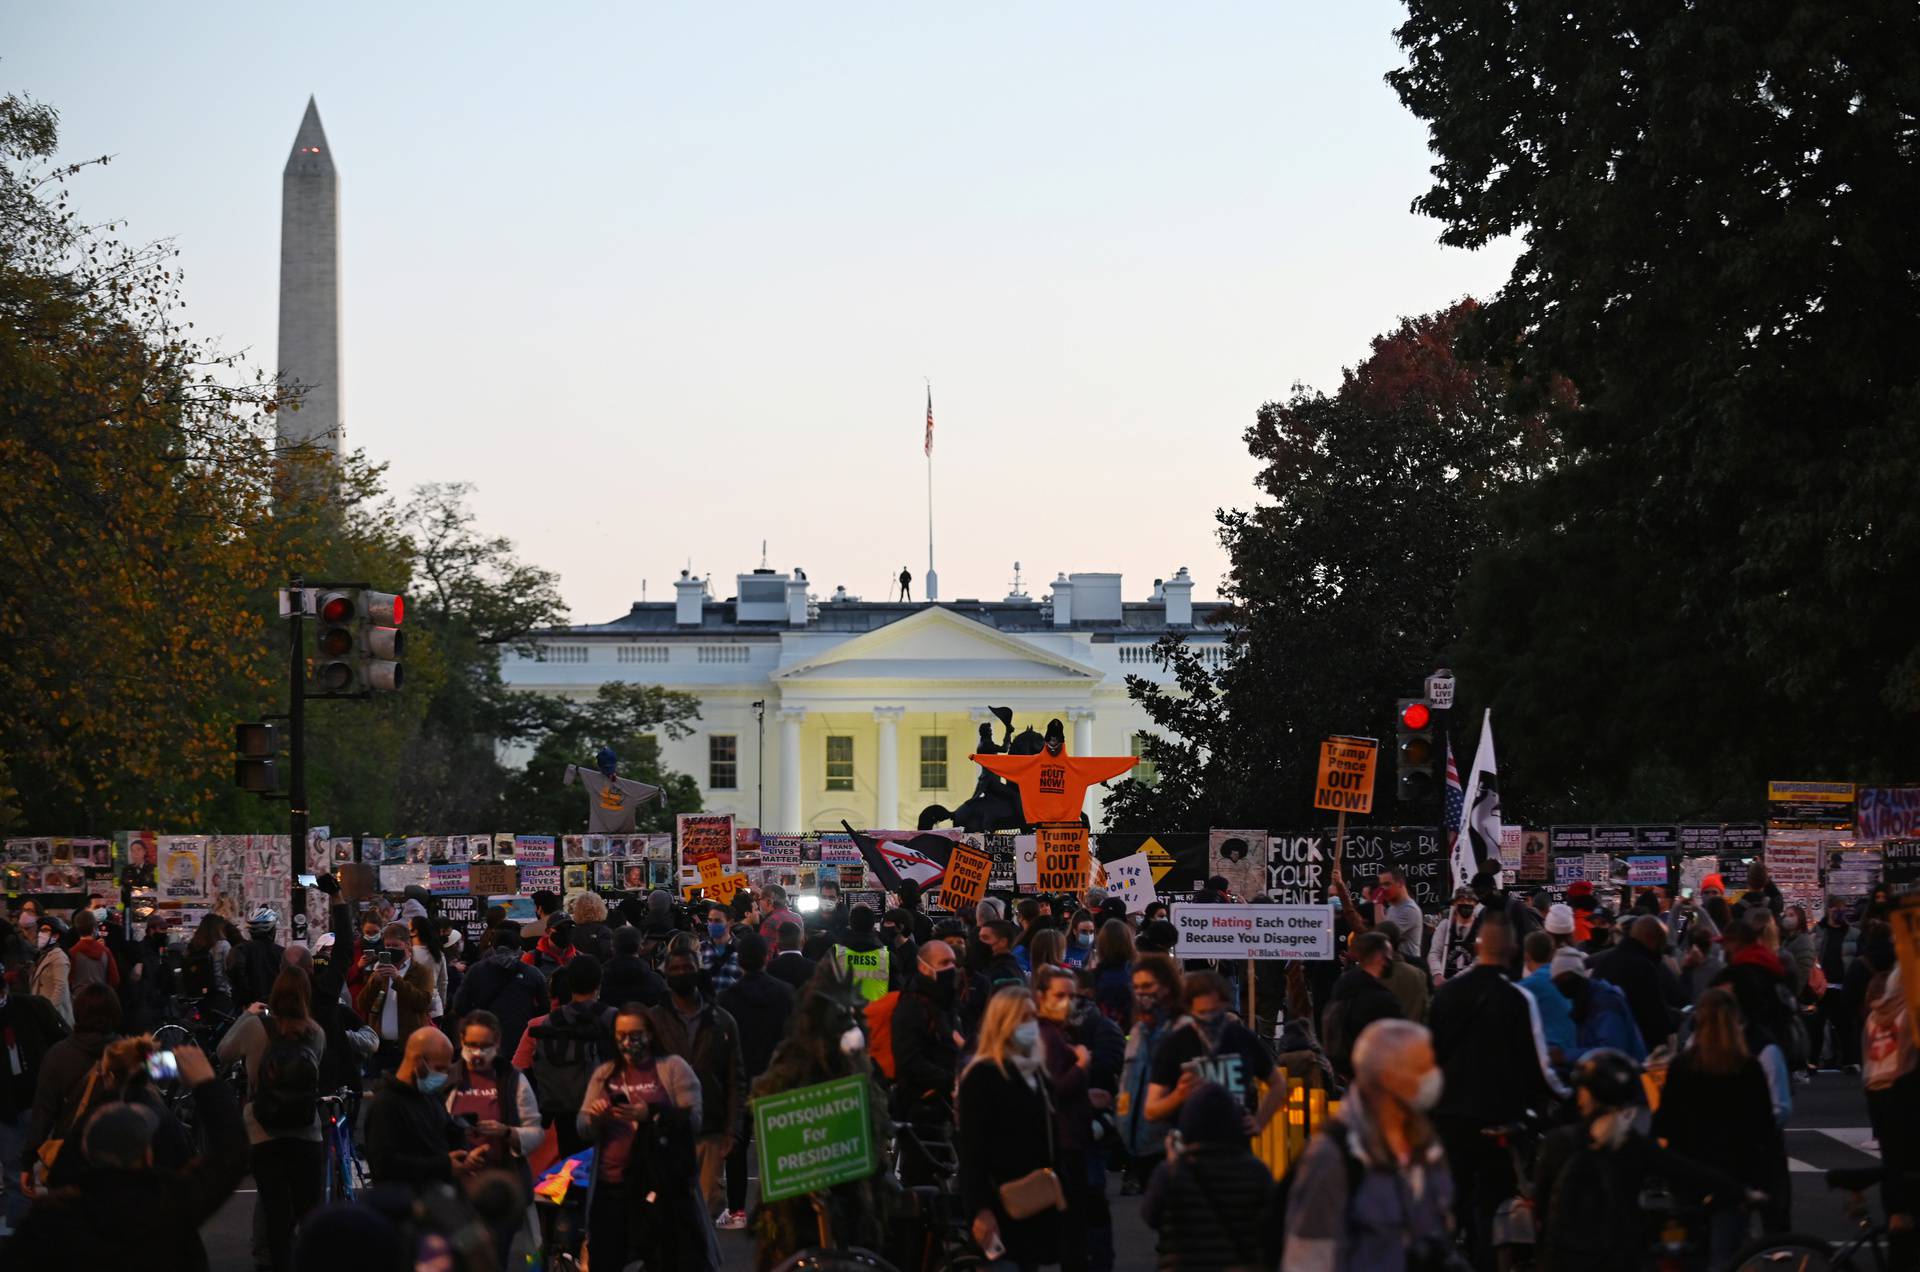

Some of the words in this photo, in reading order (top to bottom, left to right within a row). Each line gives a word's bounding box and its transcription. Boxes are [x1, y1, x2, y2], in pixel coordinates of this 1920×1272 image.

[1327, 743, 1371, 761] Trump/
[1328, 757, 1367, 772] Pence
[1040, 778, 1065, 788] NOW!
[1328, 770, 1364, 791] OUT
[1318, 788, 1368, 810] NOW!
[1041, 830, 1084, 843] Trump/
[168, 842, 198, 850] JUSTICE
[1044, 842, 1081, 852] Pence
[1268, 836, 1324, 862] FUCK
[954, 850, 988, 870] Trump/
[1046, 854, 1080, 871] OUT
[954, 862, 982, 880] Pence
[1120, 866, 1141, 877] THE
[1268, 864, 1322, 888] YOUR
[1398, 863, 1438, 878] MORE
[1556, 867, 1584, 877] LIES
[951, 876, 980, 897] OUT
[1040, 872, 1086, 889] NOW!
[1106, 878, 1136, 892] OWER
[442, 898, 473, 909] TRUMP
[1268, 888, 1320, 904] FENCE
[448, 910, 477, 920] UNFIT
[1180, 916, 1208, 930] Stop
[1212, 916, 1252, 931] Hating
[1256, 917, 1284, 928] Each
[1288, 917, 1323, 928] Other
[1186, 932, 1234, 944] Because
[1238, 933, 1260, 944] You
[1264, 933, 1317, 947] Disagree
[848, 954, 877, 966] PRESS
[1247, 950, 1320, 958] DCBlackTours.com
[767, 1096, 860, 1132] POTSQUATCH
[802, 1128, 828, 1144] For
[777, 1136, 860, 1172] PRESIDENT
